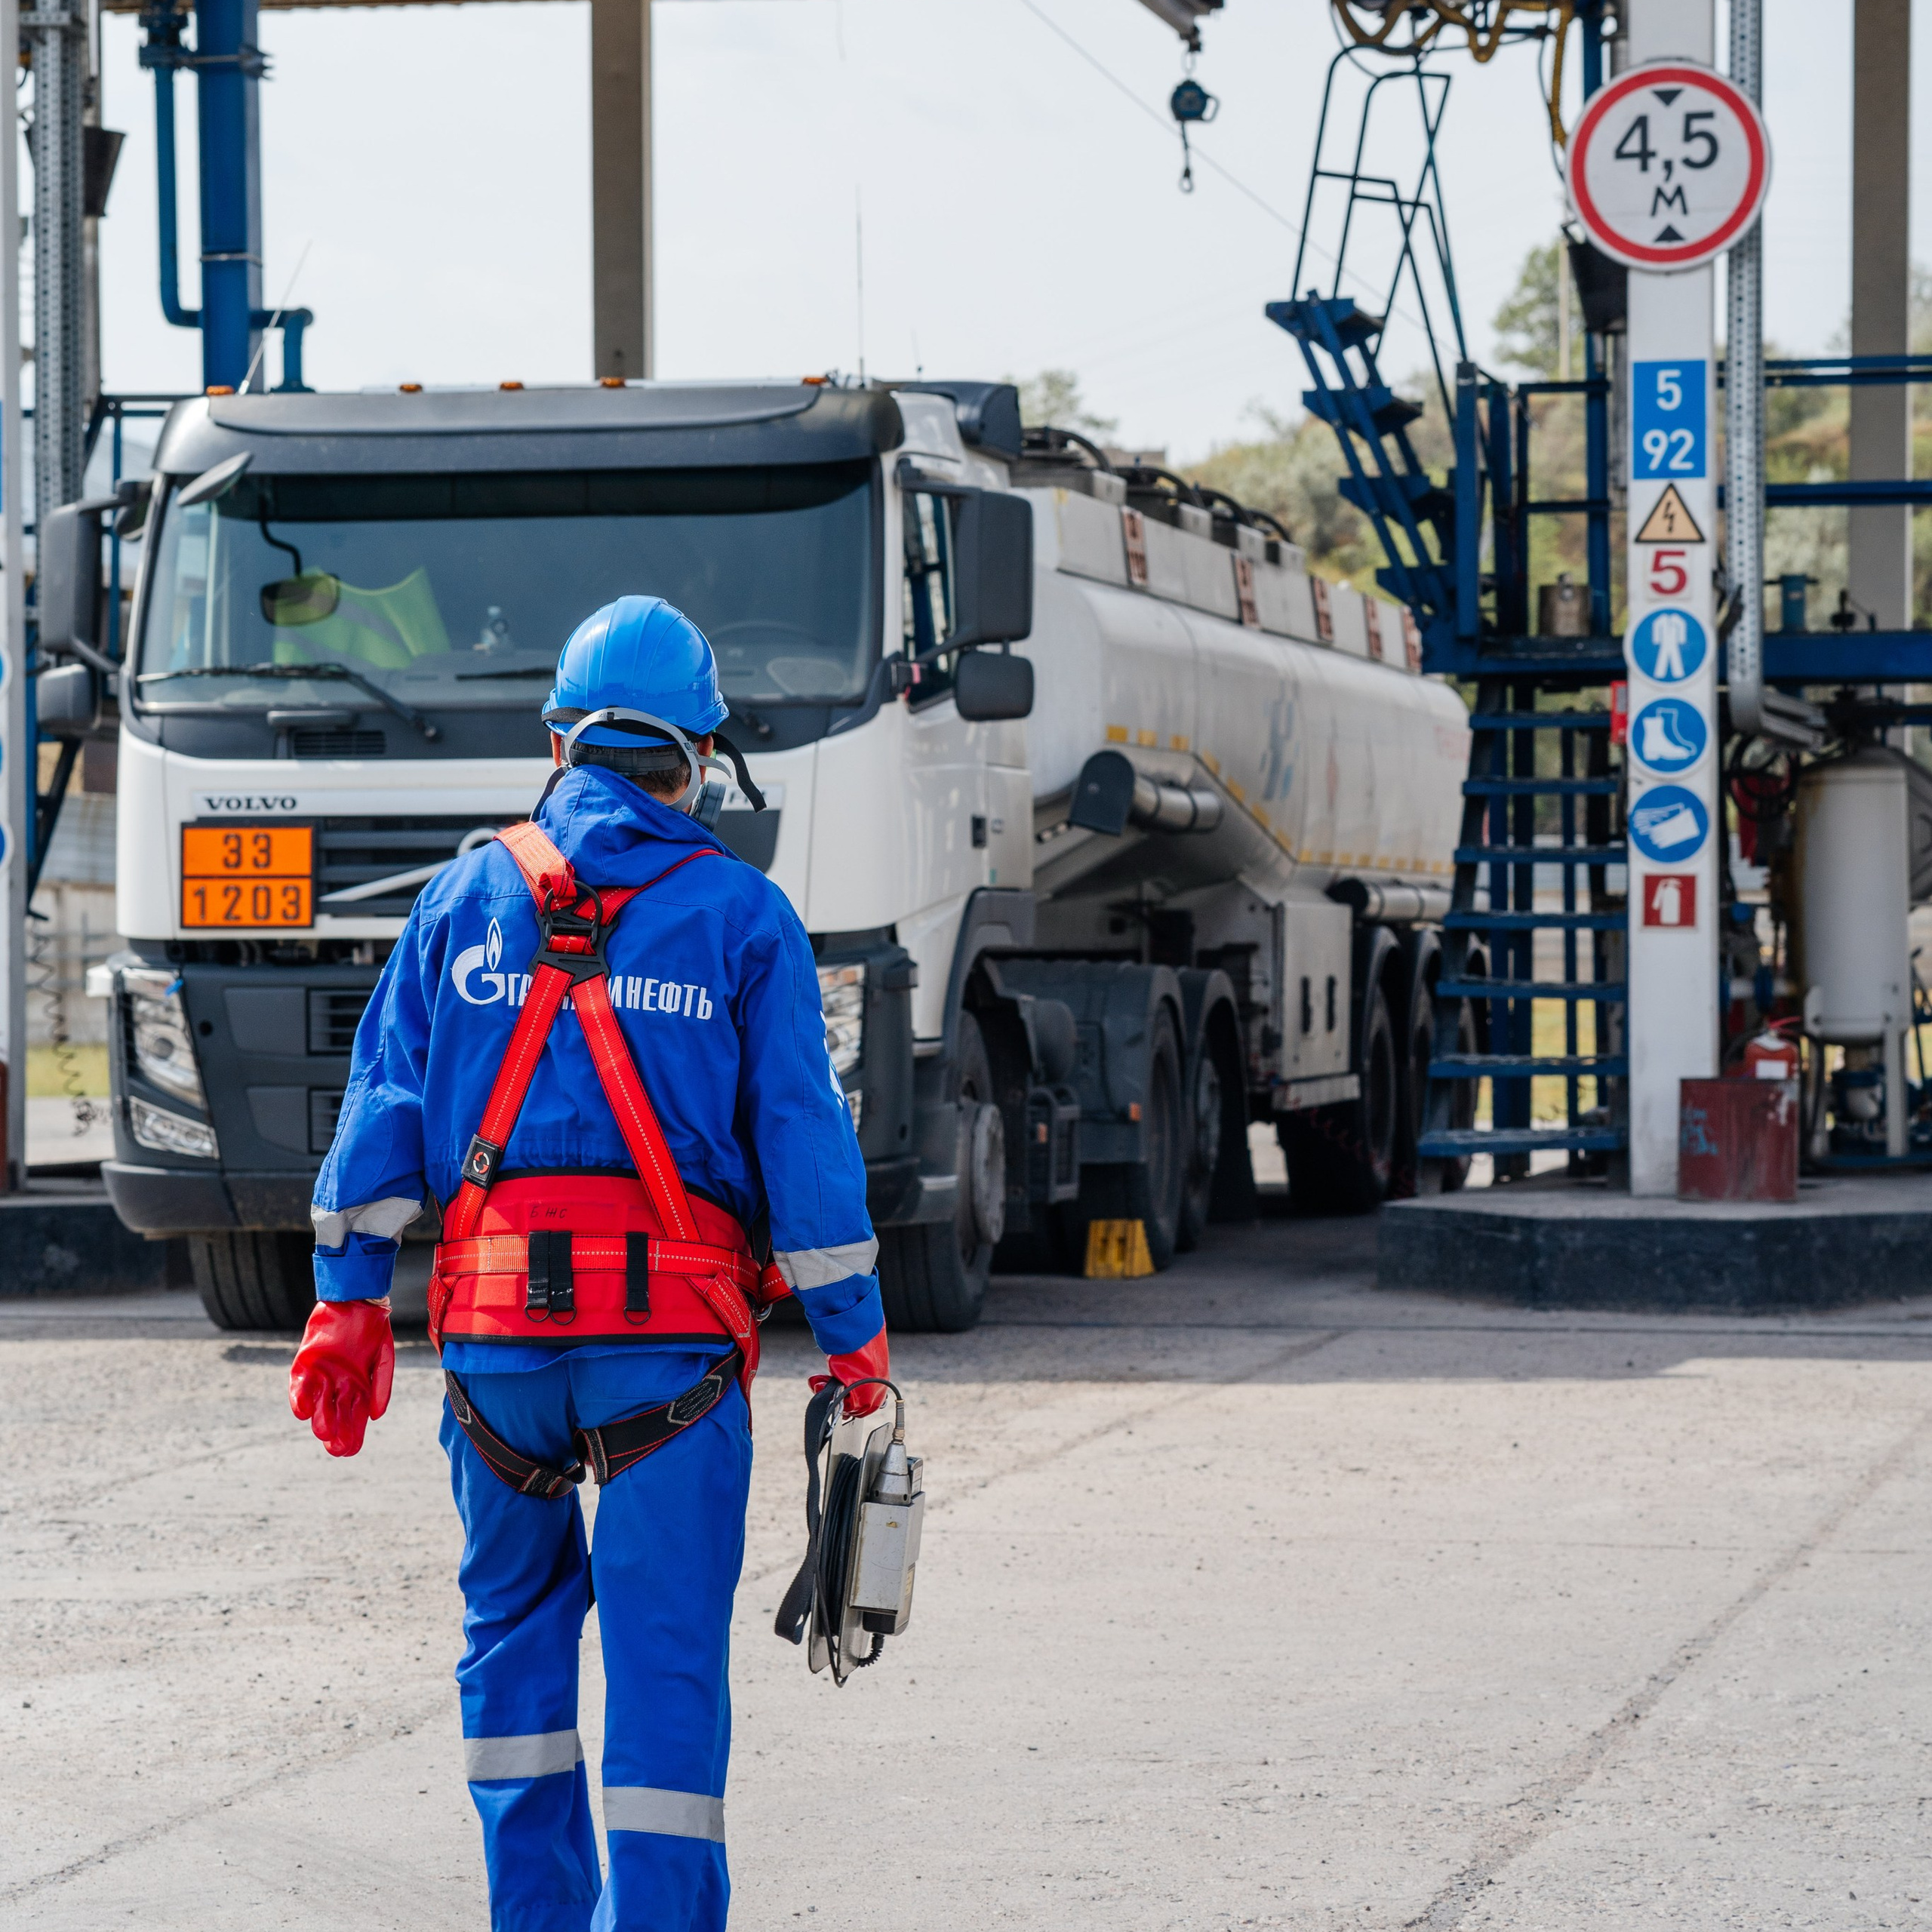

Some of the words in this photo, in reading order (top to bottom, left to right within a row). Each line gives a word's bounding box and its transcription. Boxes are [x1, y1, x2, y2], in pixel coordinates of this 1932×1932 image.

[1614, 111, 1719, 182] 4,5
[1656, 369, 1682, 411] 5
[1642, 428, 1695, 470] 92
[1649, 549, 1687, 595] 5
[205, 796, 297, 811] VOLVO
[223, 832, 272, 869] 33
[193, 884, 300, 921] 1203
